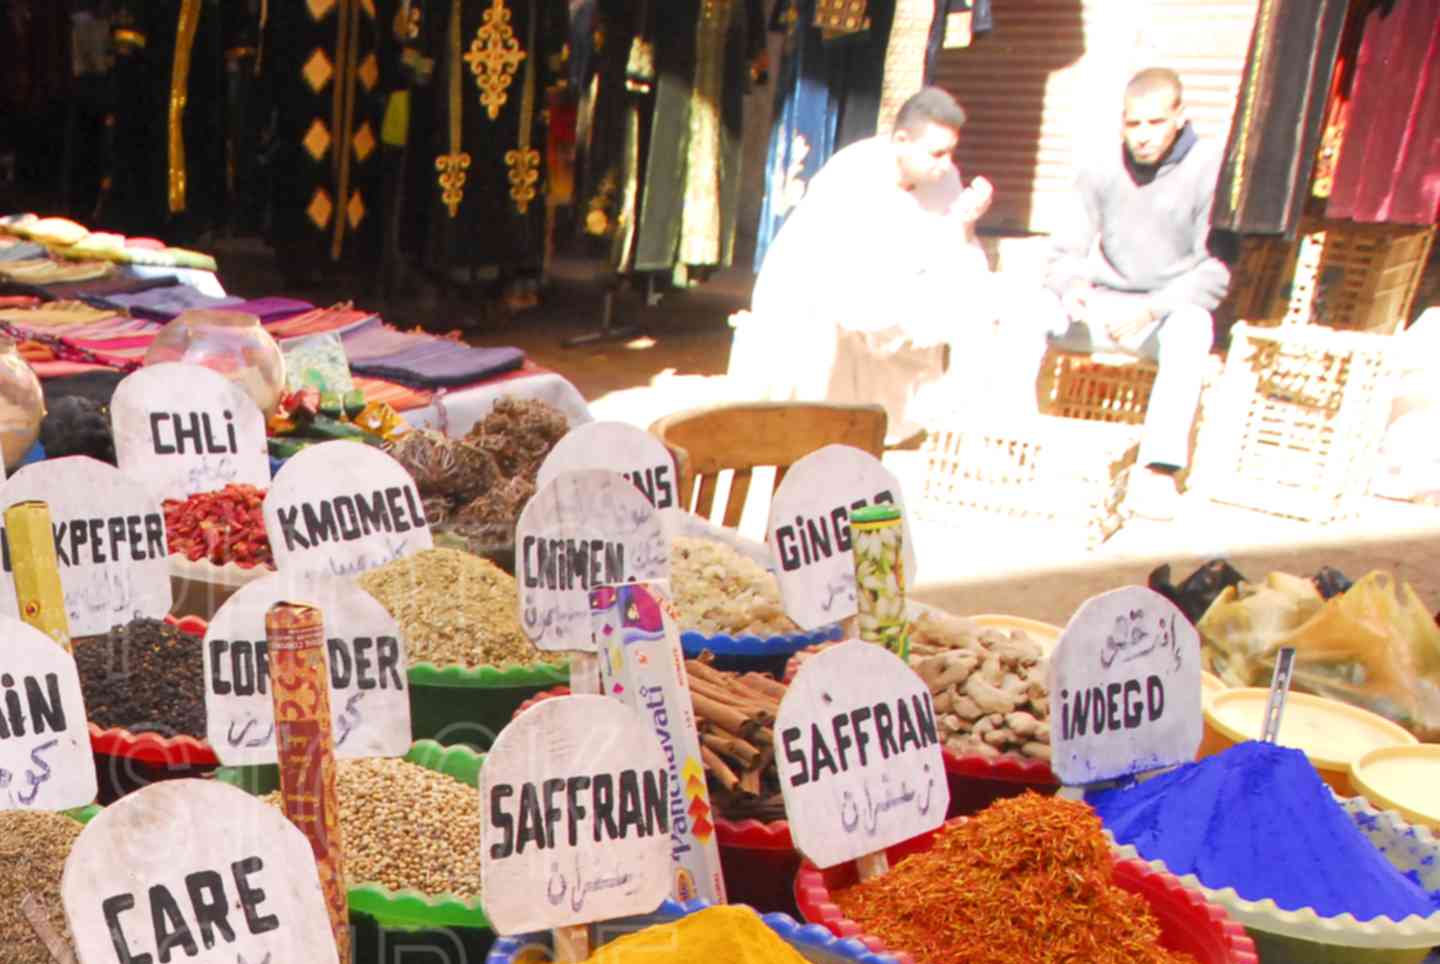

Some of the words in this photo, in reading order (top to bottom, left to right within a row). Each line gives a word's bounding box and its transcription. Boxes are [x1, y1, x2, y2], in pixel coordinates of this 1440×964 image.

[149, 409, 238, 455] CHLi
[775, 490, 894, 572] GiNG
[782, 691, 938, 787] SAFFRAN
[490, 768, 669, 859] SAFFRAN
